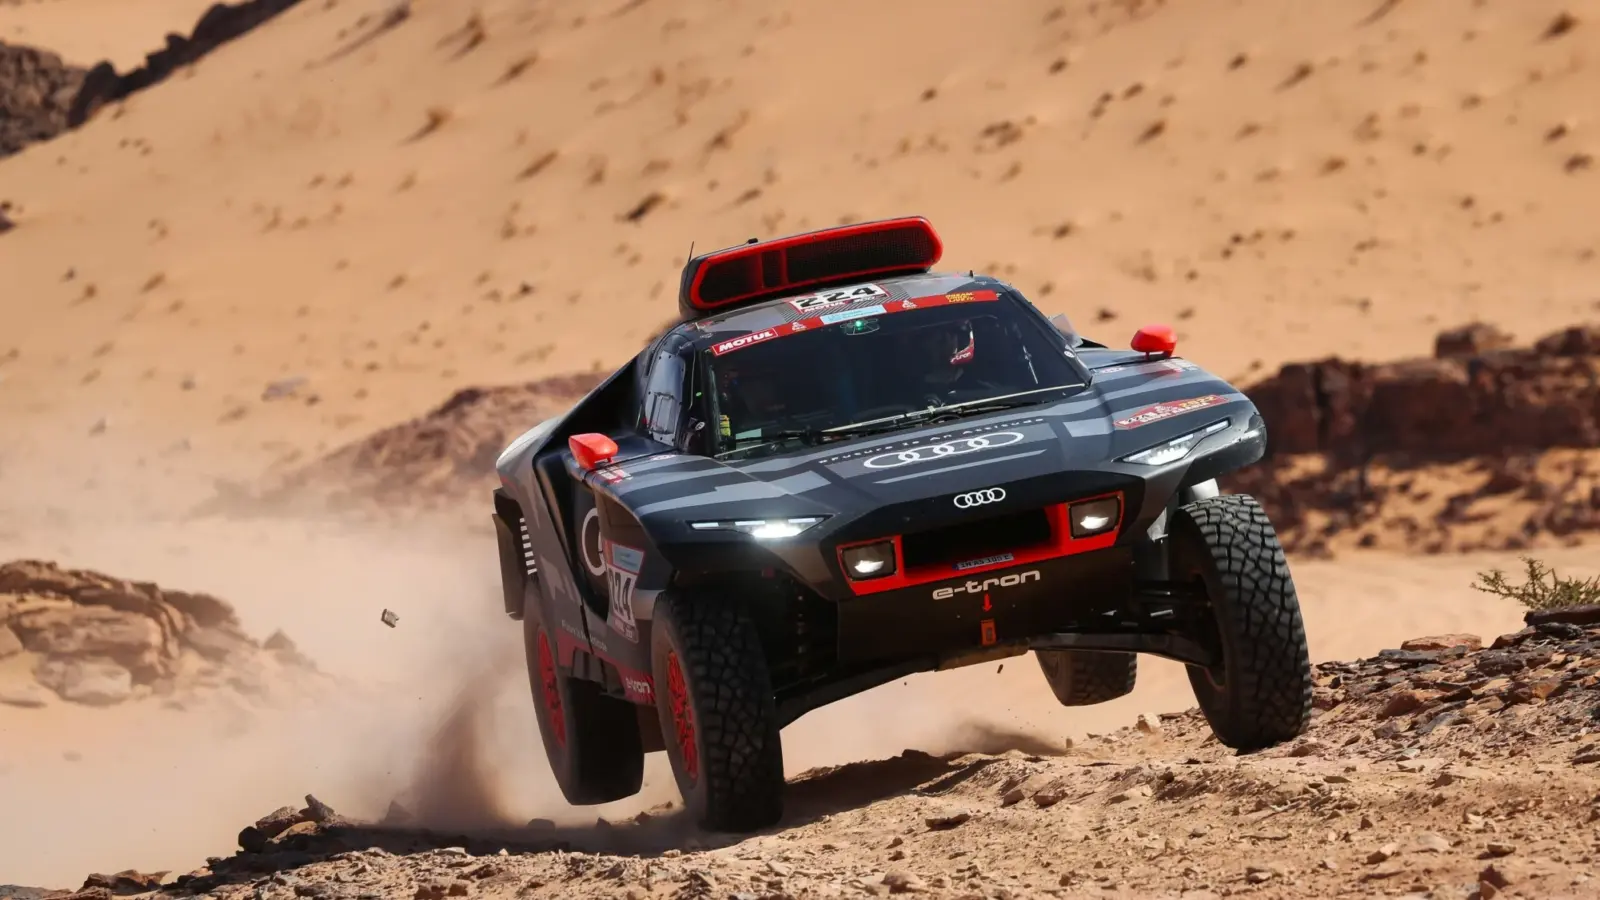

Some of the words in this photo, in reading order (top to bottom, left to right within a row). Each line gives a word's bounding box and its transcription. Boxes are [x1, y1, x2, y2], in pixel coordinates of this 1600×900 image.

[795, 287, 877, 307] 224
[719, 331, 774, 352] MOTUL
[932, 570, 1041, 600] e-tron
